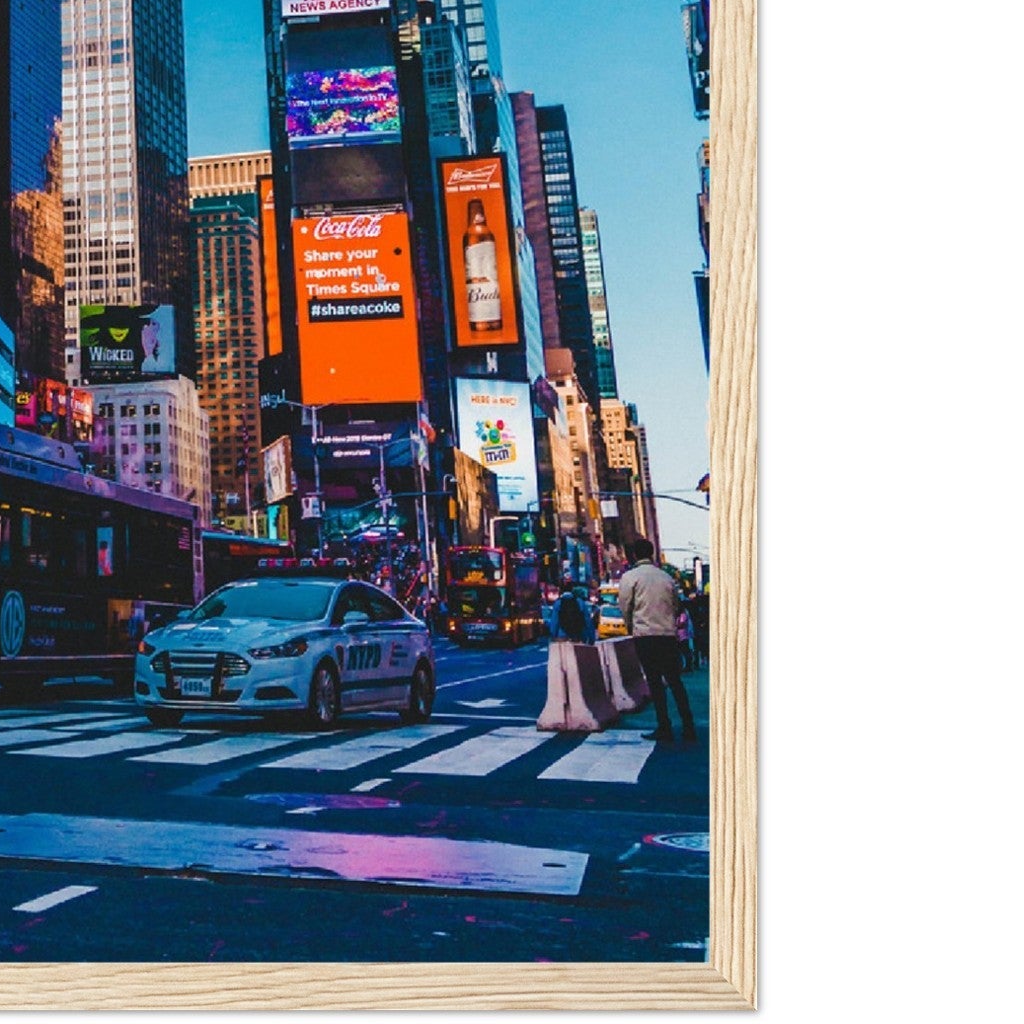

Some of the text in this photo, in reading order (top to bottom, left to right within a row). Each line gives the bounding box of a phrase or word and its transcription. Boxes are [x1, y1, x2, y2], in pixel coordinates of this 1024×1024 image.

[290, 0, 326, 13] NEWS
[313, 215, 383, 240] Coca-Cola
[303, 248, 378, 263] Share your
[305, 264, 379, 279] moment in
[306, 280, 400, 296] Times Square
[311, 301, 401, 317] #shareacoke
